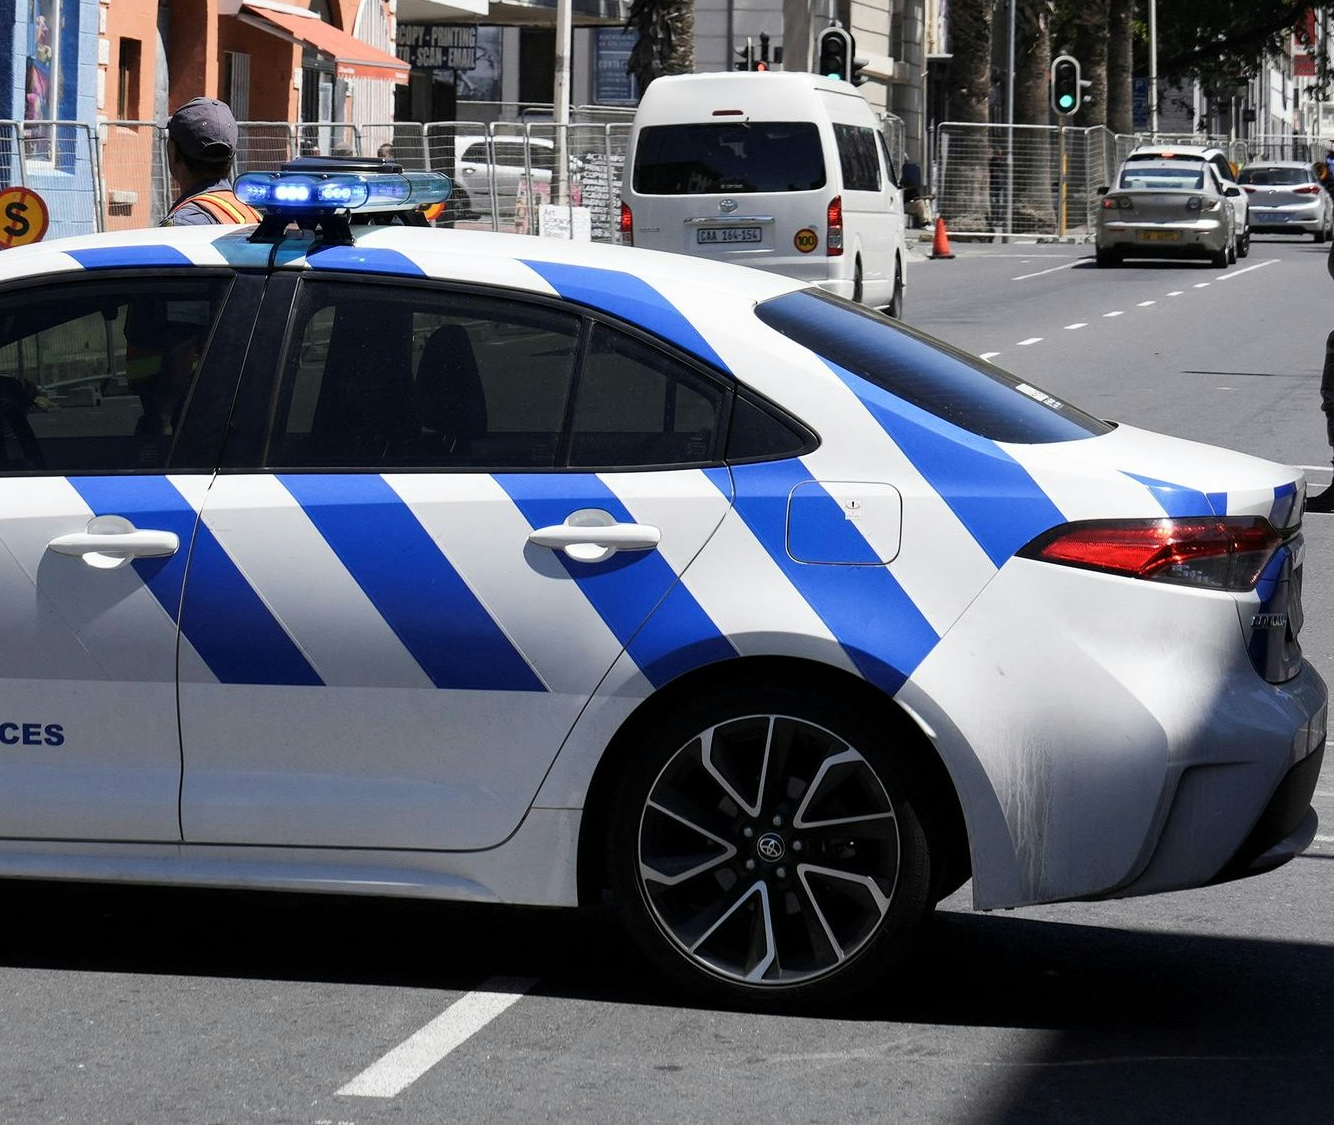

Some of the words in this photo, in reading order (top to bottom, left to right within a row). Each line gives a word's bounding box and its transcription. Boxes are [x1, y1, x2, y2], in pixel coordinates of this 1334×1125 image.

[431, 26, 476, 48] PRINTING
[416, 46, 442, 67] SCAN
[448, 48, 476, 68] EMAIL
[3, 202, 30, 236] S
[700, 230, 717, 242] CAA
[722, 229, 758, 242] 164-154
[797, 235, 815, 246] 100
